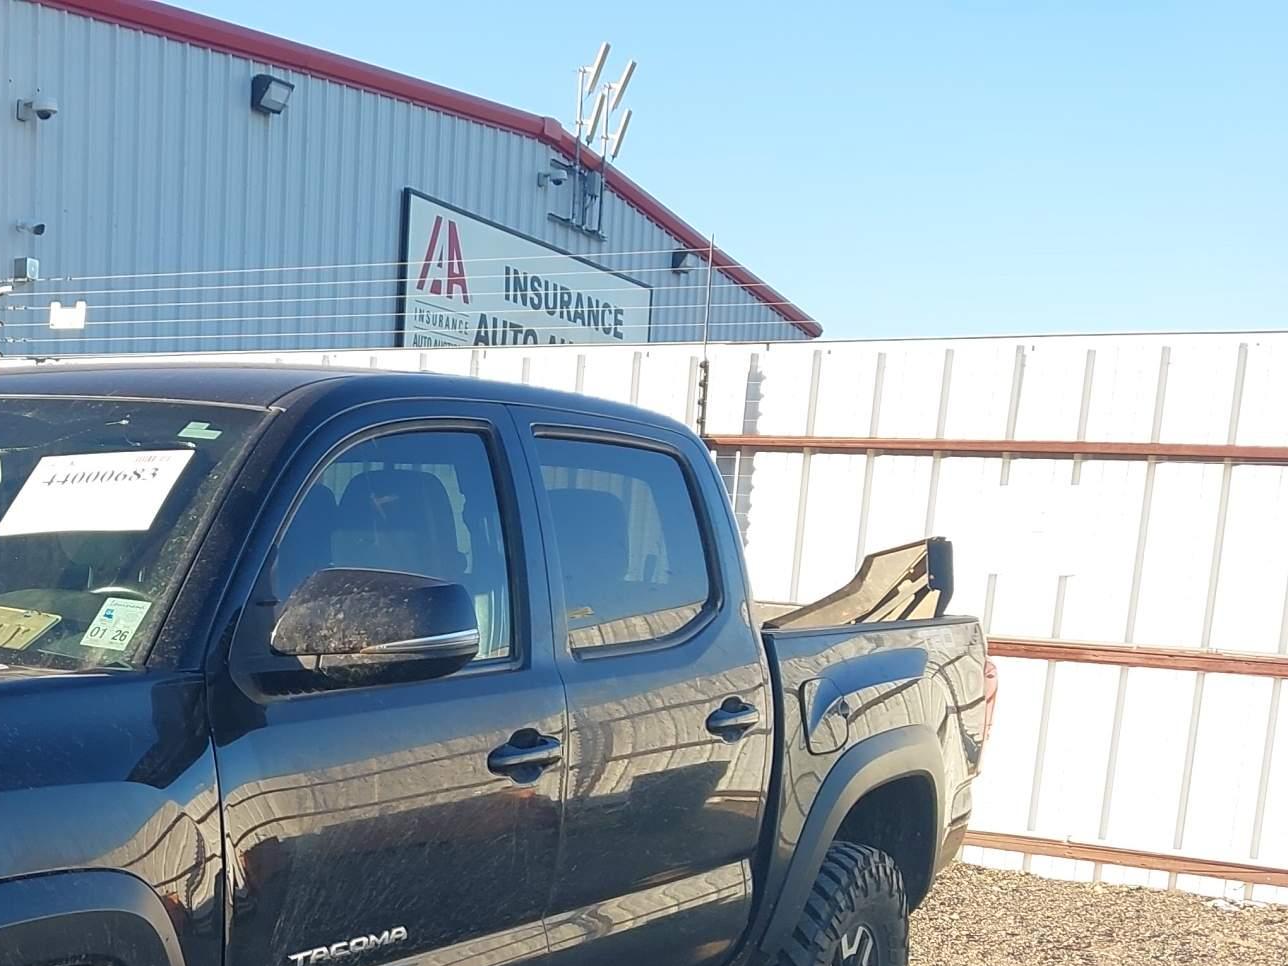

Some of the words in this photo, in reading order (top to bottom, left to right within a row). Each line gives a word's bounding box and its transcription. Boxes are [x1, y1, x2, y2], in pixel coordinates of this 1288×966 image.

[505, 265, 624, 340] INSURANCE
[414, 307, 469, 335] INSURANCE
[42, 467, 159, 486] 44000683
[89, 626, 108, 639] 01
[112, 629, 130, 642] 26
